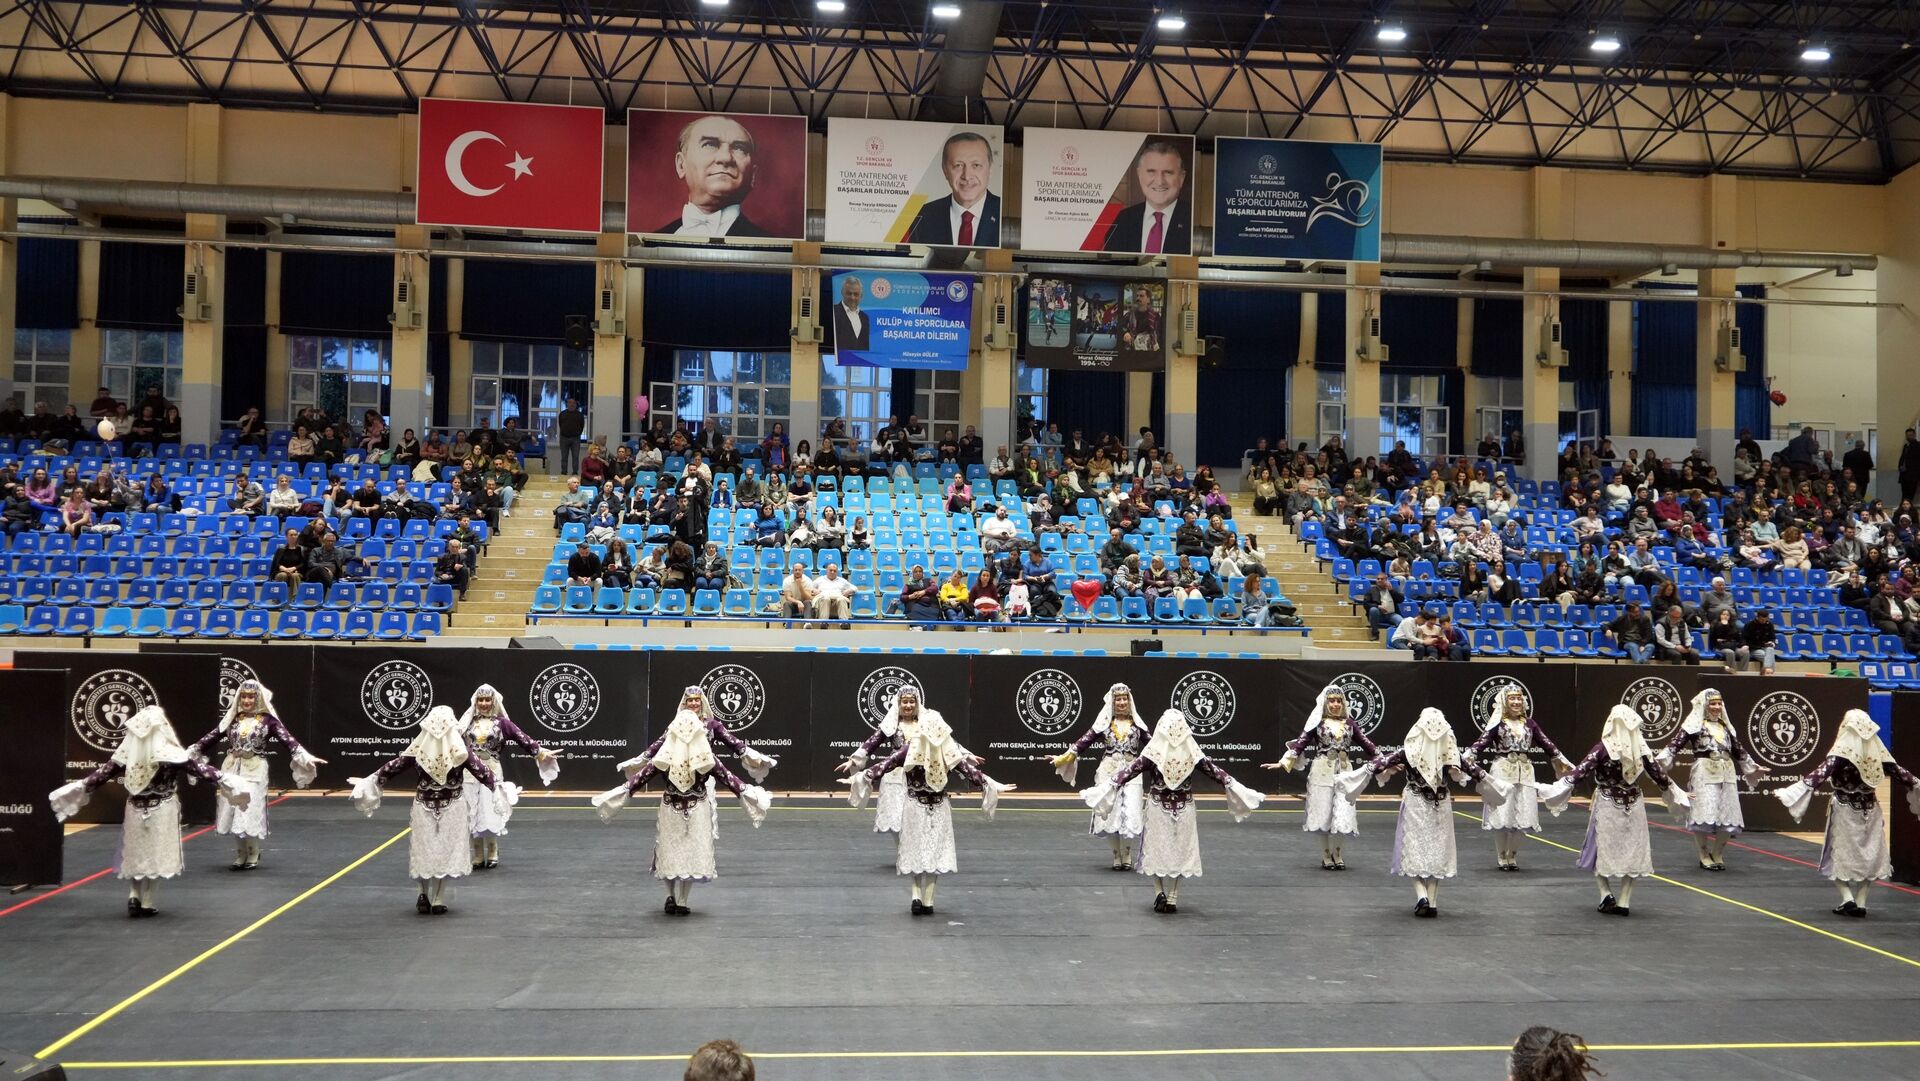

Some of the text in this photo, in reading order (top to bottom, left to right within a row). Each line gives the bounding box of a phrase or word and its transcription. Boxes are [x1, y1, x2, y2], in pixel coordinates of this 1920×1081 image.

[858, 171, 898, 180] ANTRENÖR
[841, 179, 905, 188] SPORCULARIMIZA
[1054, 181, 1092, 189] ANTRENÖR
[1038, 188, 1100, 197] SPORCULARIMIZA
[1236, 188, 1300, 199] TÜM ANTRENÖR
[1238, 198, 1308, 208] SPORCULARIMIZA
[1228, 208, 1306, 217] BAŞARILAR DİLİYORUM
[902, 306, 940, 315] KATILIMCI
[876, 316, 902, 326] KULÜP
[914, 319, 965, 328] SPORCULARA
[883, 330, 958, 340] BAŞARILAR DİLERİM
[108, 685, 132, 694] GENÇLİK
[130, 691, 139, 700] VE
